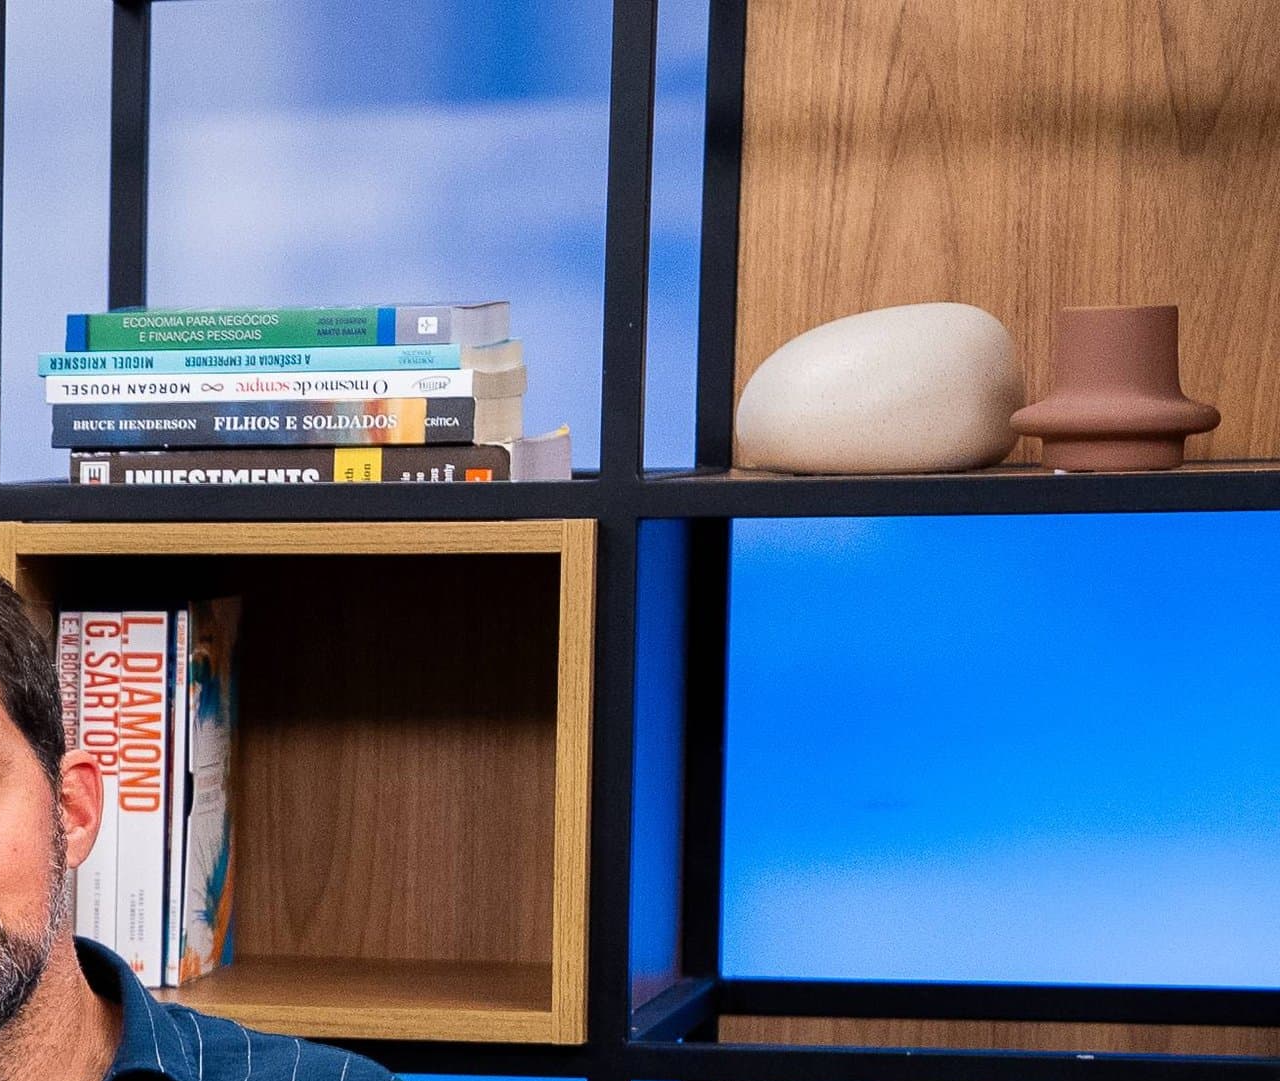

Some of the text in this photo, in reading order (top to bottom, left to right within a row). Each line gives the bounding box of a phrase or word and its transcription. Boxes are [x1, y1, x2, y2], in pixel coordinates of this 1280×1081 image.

[123, 313, 280, 328] ECONOMIA PARA NEGÓCIOS
[139, 329, 262, 344] E FINANÇAS PESSOAIS
[50, 354, 311, 370] A ESSÊNCIA DE EMPREENDER MIGUEL KRIGSNER
[62, 377, 388, 396] O mesmo de sempre MORGAN HOUSEL
[73, 414, 460, 431] BRUCE HENDERSON FILHOS E SOLDADOS CRÍTICA
[84, 619, 121, 646] G.
[118, 616, 165, 813] L. DIAMOND
